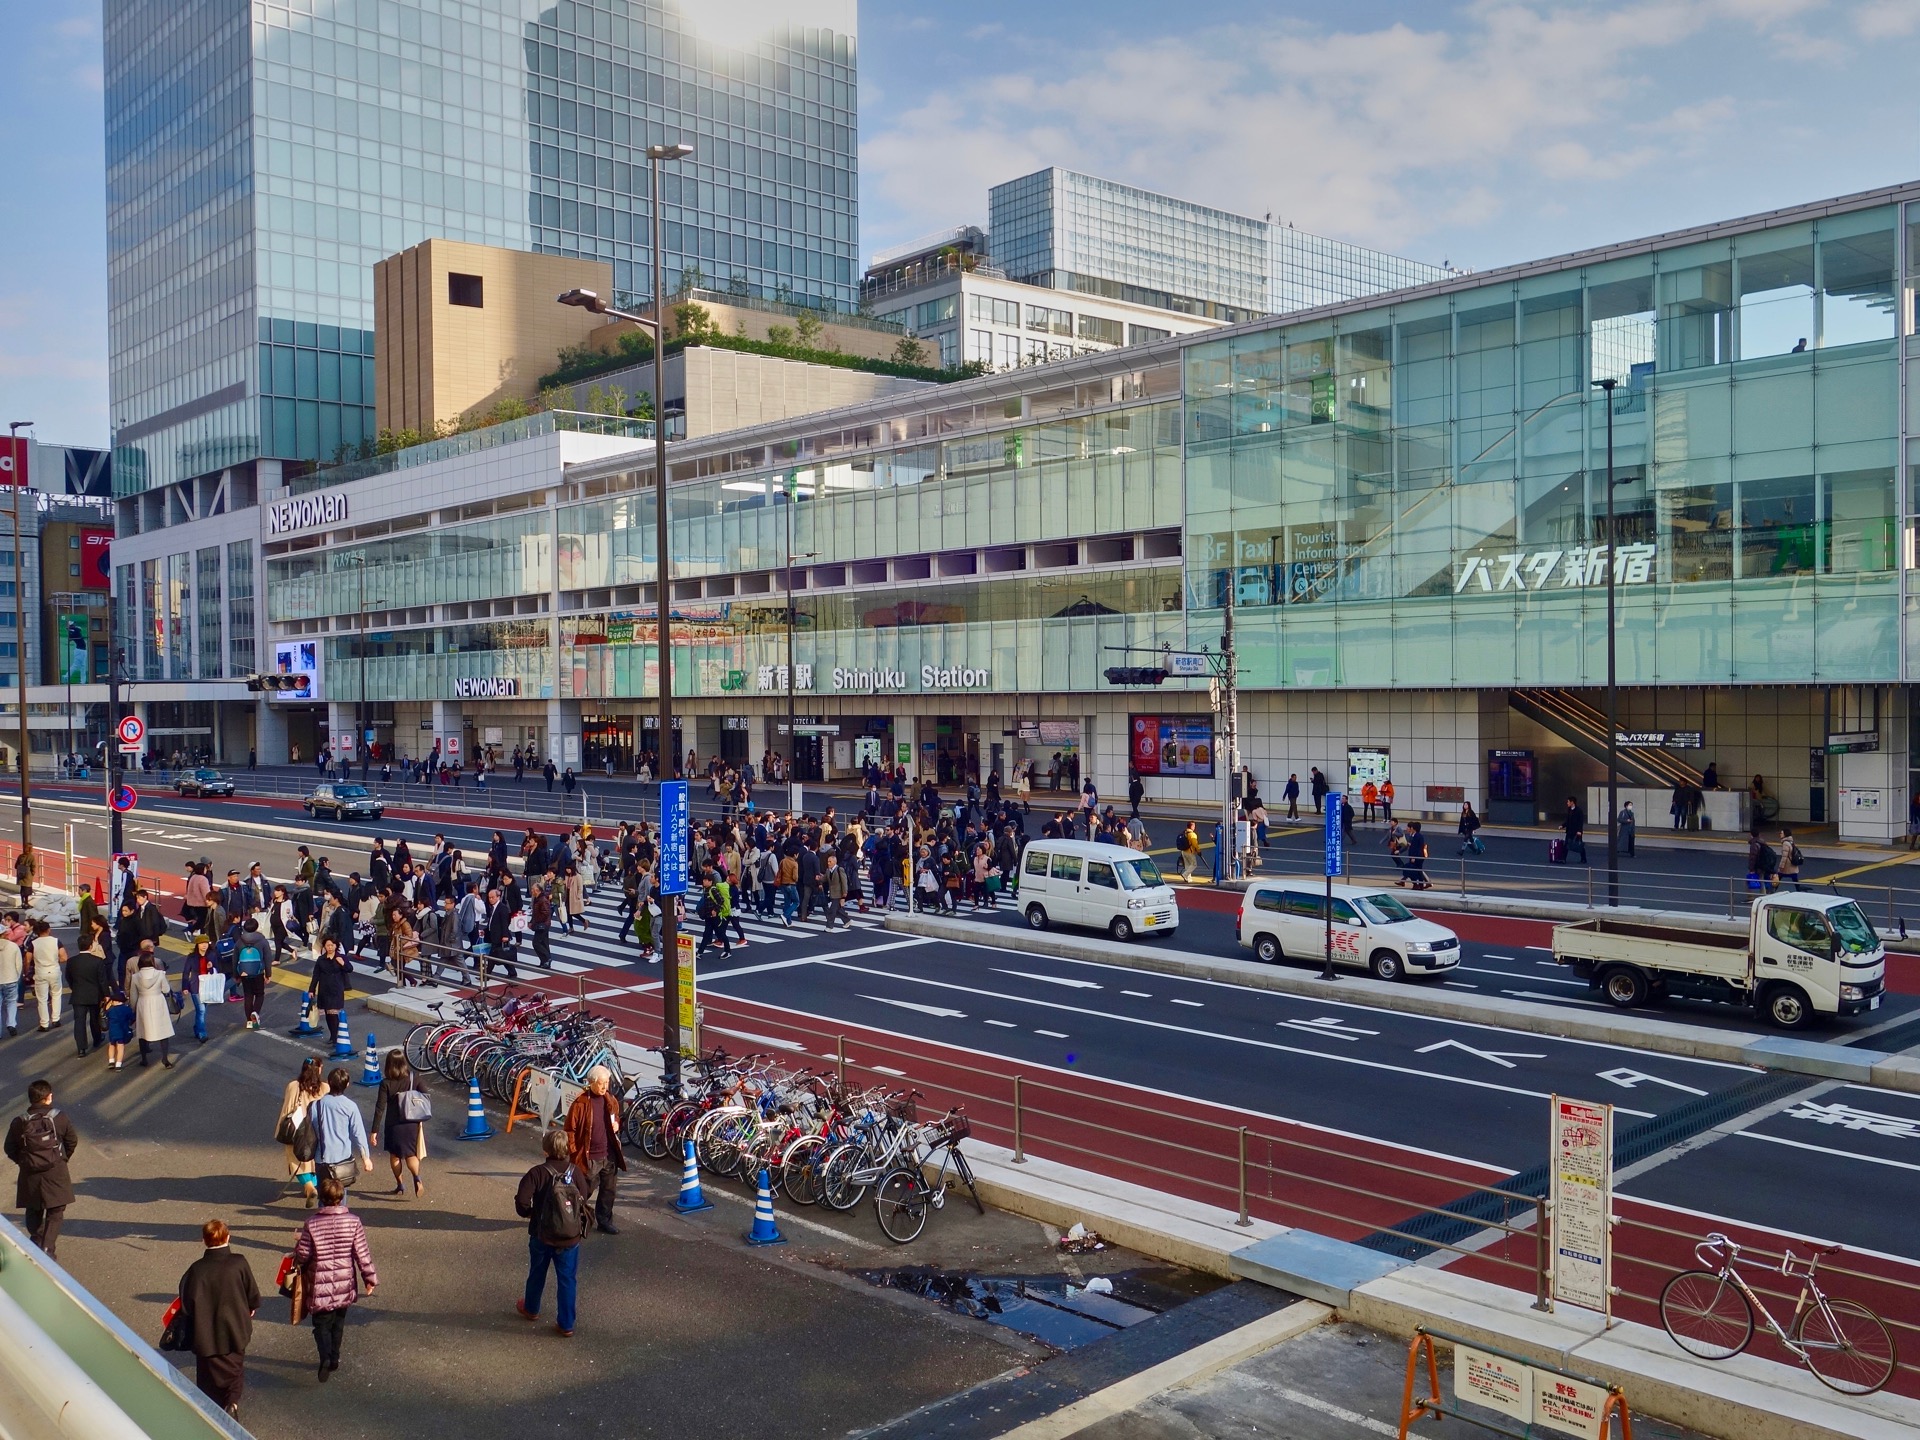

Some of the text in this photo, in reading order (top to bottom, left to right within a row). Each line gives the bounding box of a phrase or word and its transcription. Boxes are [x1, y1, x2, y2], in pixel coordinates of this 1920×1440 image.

[1290, 352, 1321, 371] Bus
[270, 493, 347, 534] NEWoMan
[1236, 537, 1272, 559] Taxi
[1294, 530, 1335, 545] Tourist
[1295, 543, 1368, 560] Information
[1294, 562, 1335, 575] Center
[1454, 542, 1656, 593] バスタ新宿
[454, 677, 515, 697] NEWoMan
[720, 670, 743, 691] JR
[758, 664, 813, 690] 新宿駅
[833, 664, 988, 693] Shinjuku Station
[1629, 733, 1664, 742] バスタ新宿
[670, 804, 678, 871] バスタ新宿へは
[663, 843, 671, 891] 入れません
[1556, 1382, 1577, 1398] 警告
